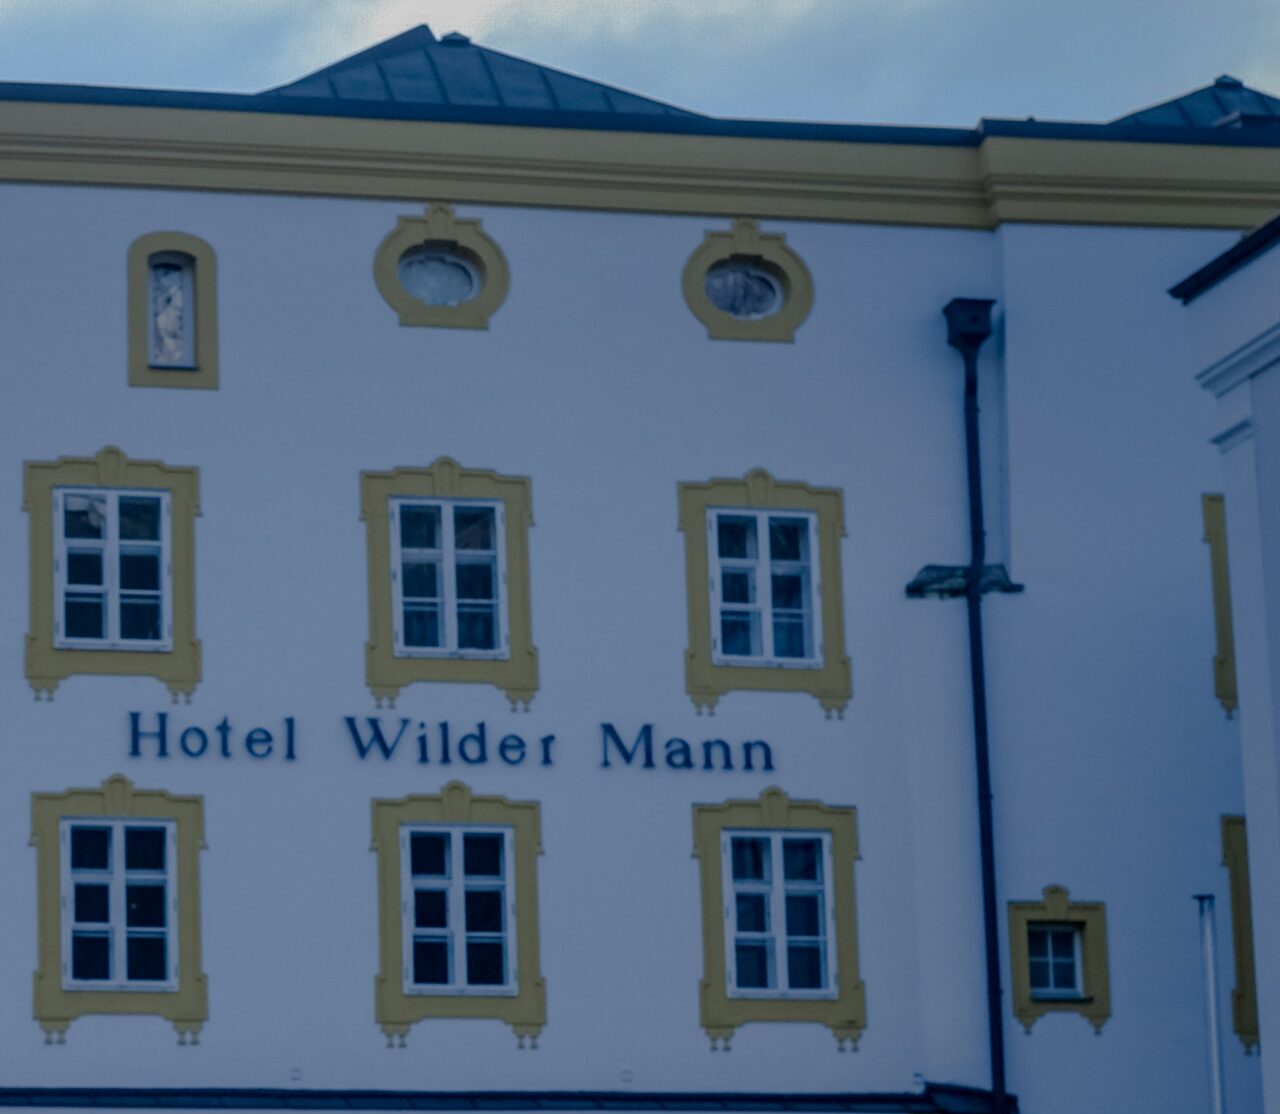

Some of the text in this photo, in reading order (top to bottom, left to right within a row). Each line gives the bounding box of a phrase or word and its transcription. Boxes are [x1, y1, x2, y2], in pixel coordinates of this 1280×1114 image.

[129, 711, 776, 772] Hotel Wilder Mann
